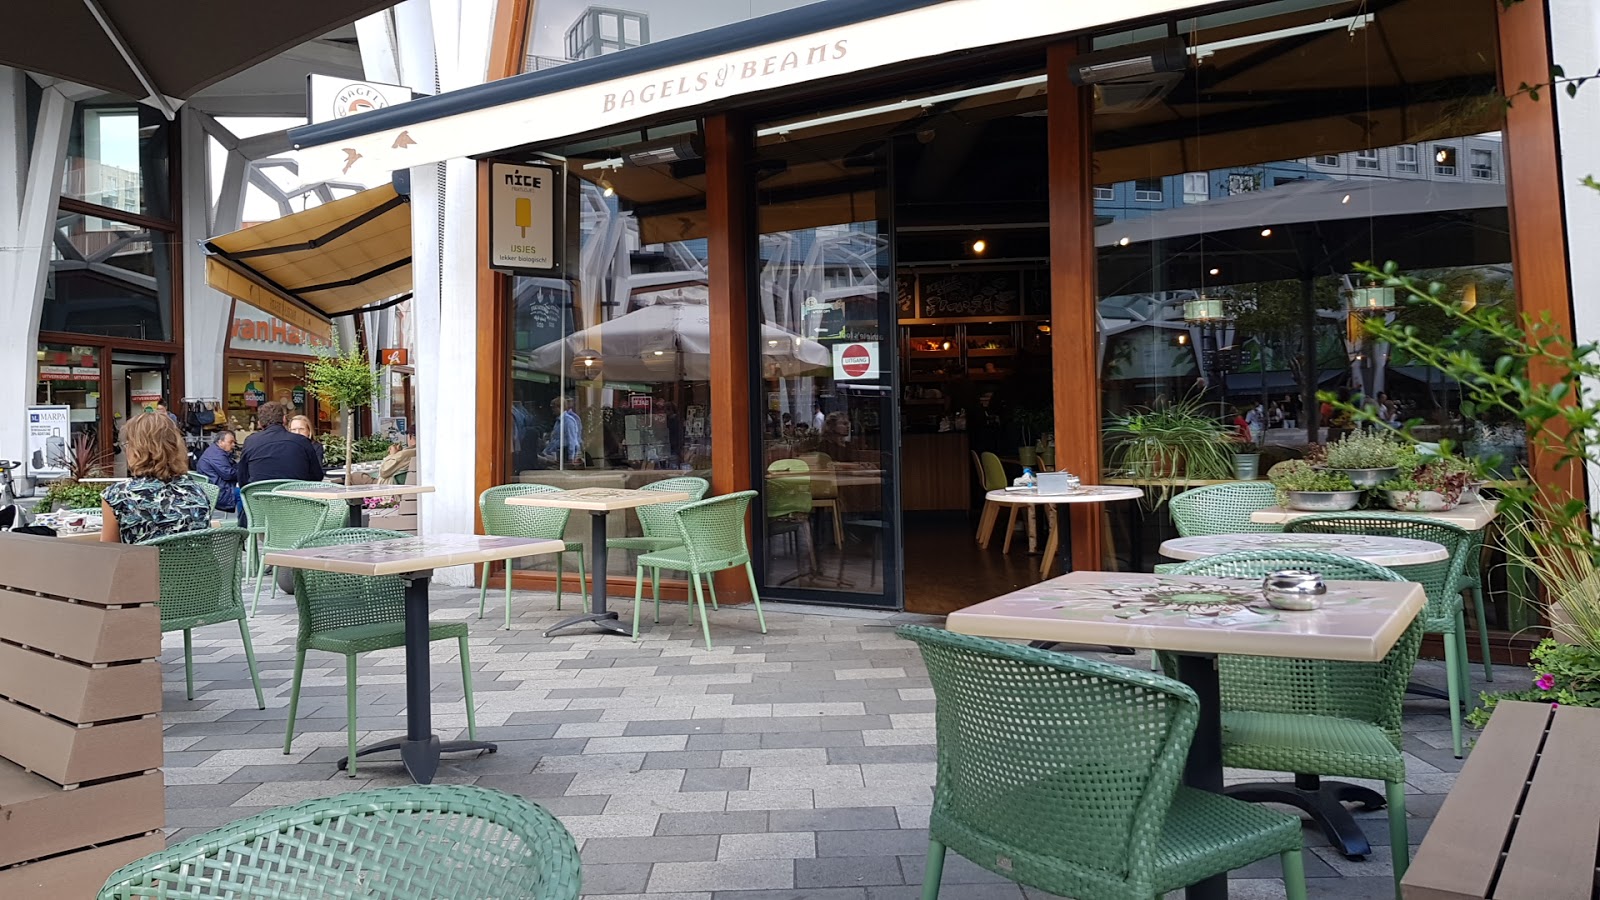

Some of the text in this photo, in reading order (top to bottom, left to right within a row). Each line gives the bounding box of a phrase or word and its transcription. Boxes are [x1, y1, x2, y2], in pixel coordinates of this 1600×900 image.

[602, 71, 709, 113] BAGELS
[740, 39, 848, 80] BEANS
[340, 87, 384, 109] BAGELS
[510, 244, 536, 254] IJSJES
[518, 255, 547, 264] biologisch!
